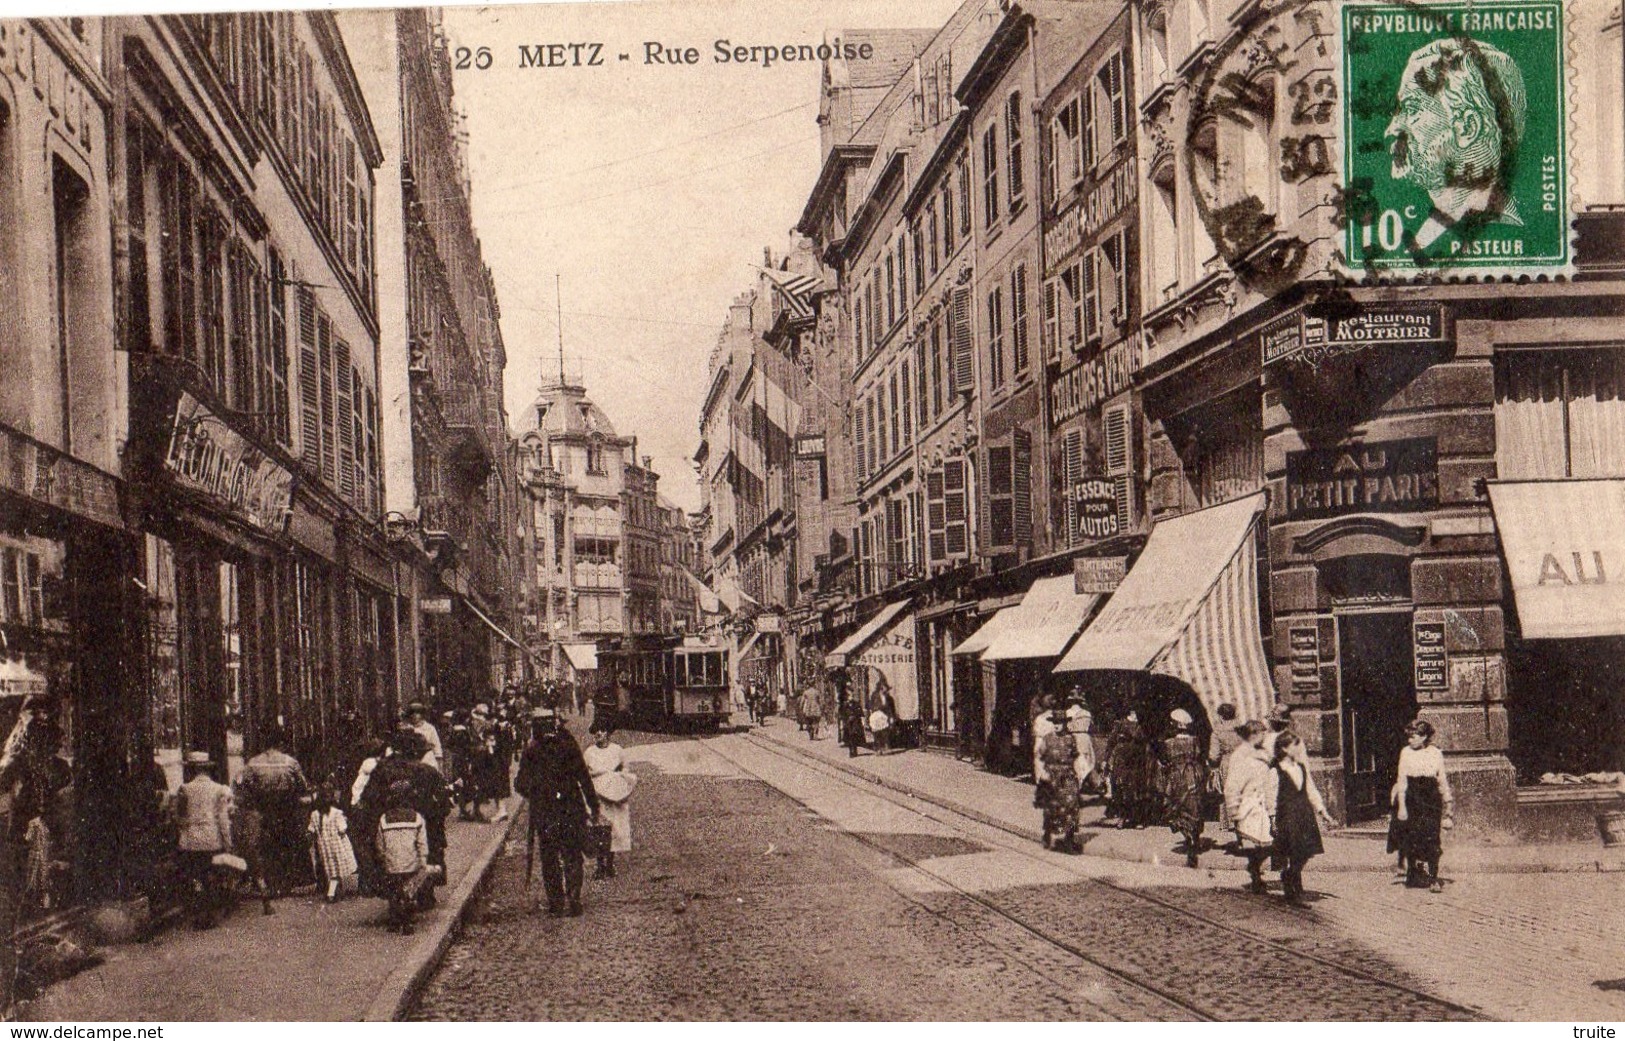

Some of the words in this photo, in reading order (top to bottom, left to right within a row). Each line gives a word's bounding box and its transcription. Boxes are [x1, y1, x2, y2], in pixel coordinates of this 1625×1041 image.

[1542, 155, 1556, 211] POSTES
[1451, 240, 1524, 255] PASTEUR
[1335, 326, 1432, 341] MOITRIER
[1333, 450, 1386, 473] AU
[1076, 480, 1116, 501] ESSENCE
[1289, 478, 1357, 510] PETIT
[1364, 472, 1436, 503] PARIS
[1086, 503, 1109, 513] POUR
[1080, 514, 1117, 536] AUTOS
[1538, 550, 1606, 586] AU
